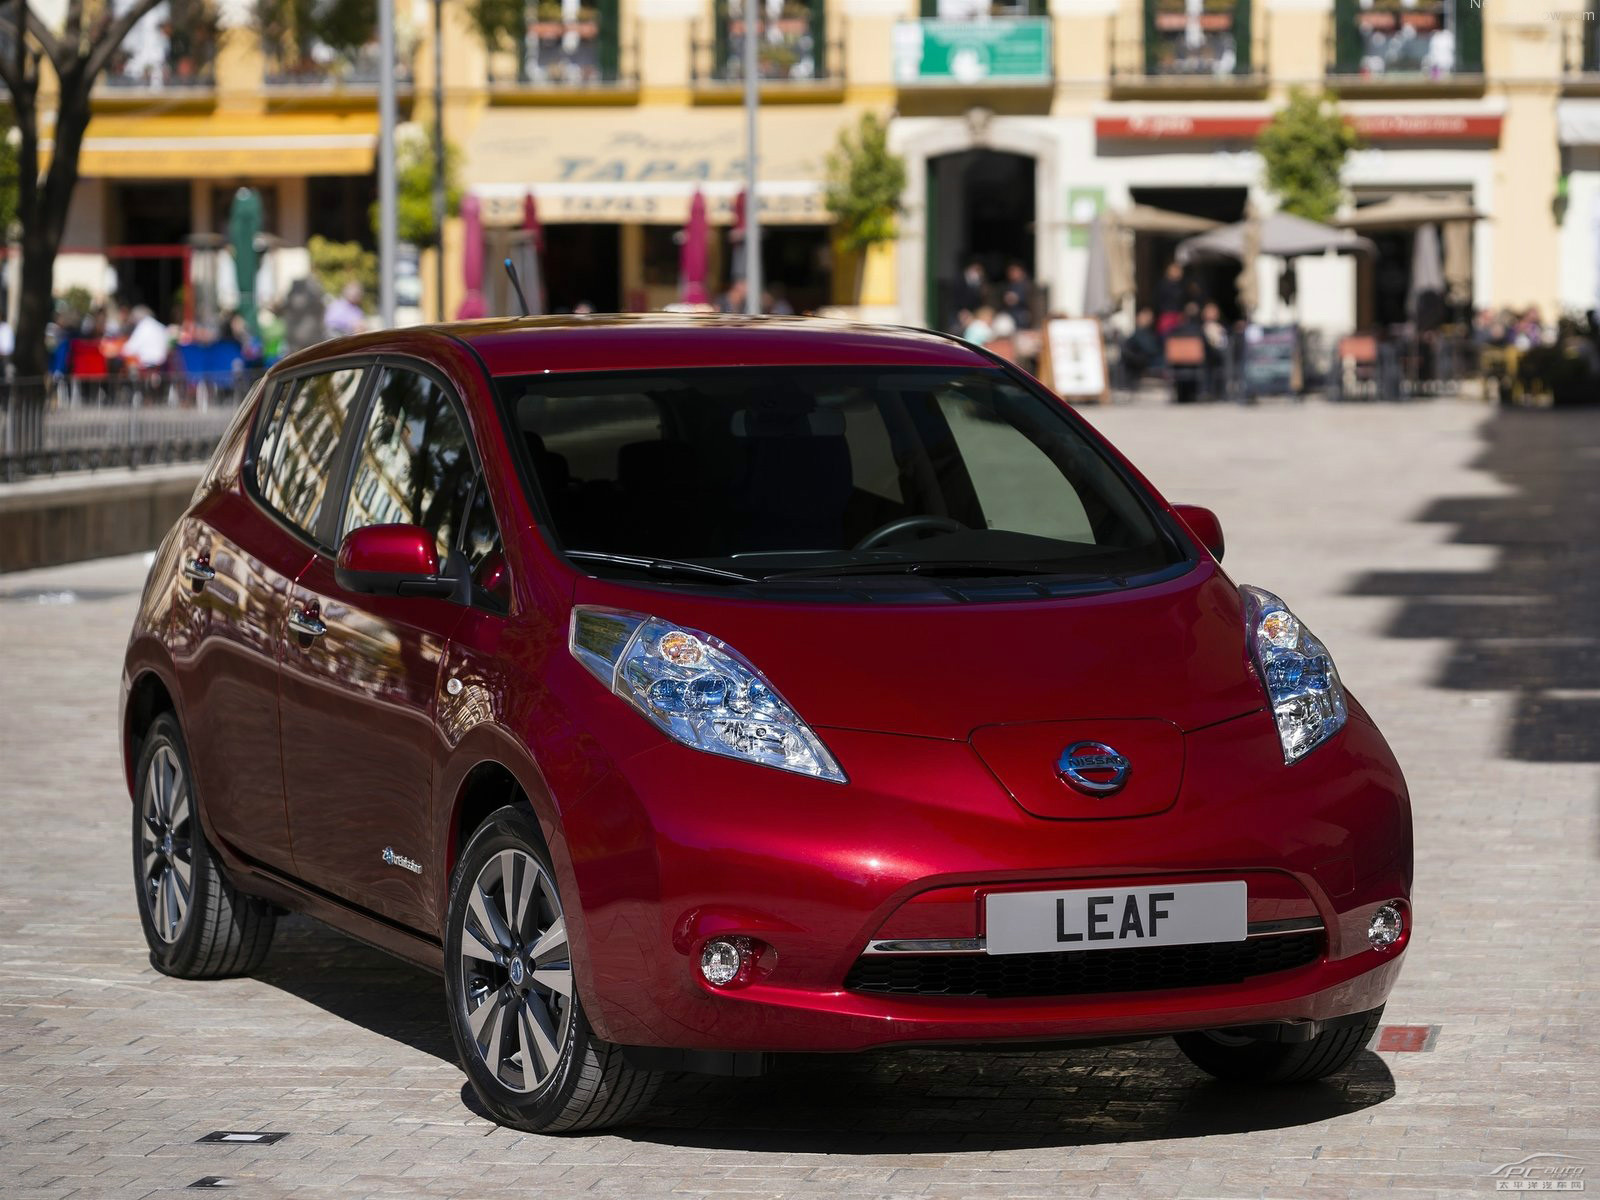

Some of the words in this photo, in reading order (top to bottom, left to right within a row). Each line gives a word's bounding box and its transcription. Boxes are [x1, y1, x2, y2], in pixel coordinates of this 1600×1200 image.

[556, 156, 755, 181] TAPAS
[1068, 755, 1127, 768] NISSAN
[1056, 892, 1175, 943] LEAF
